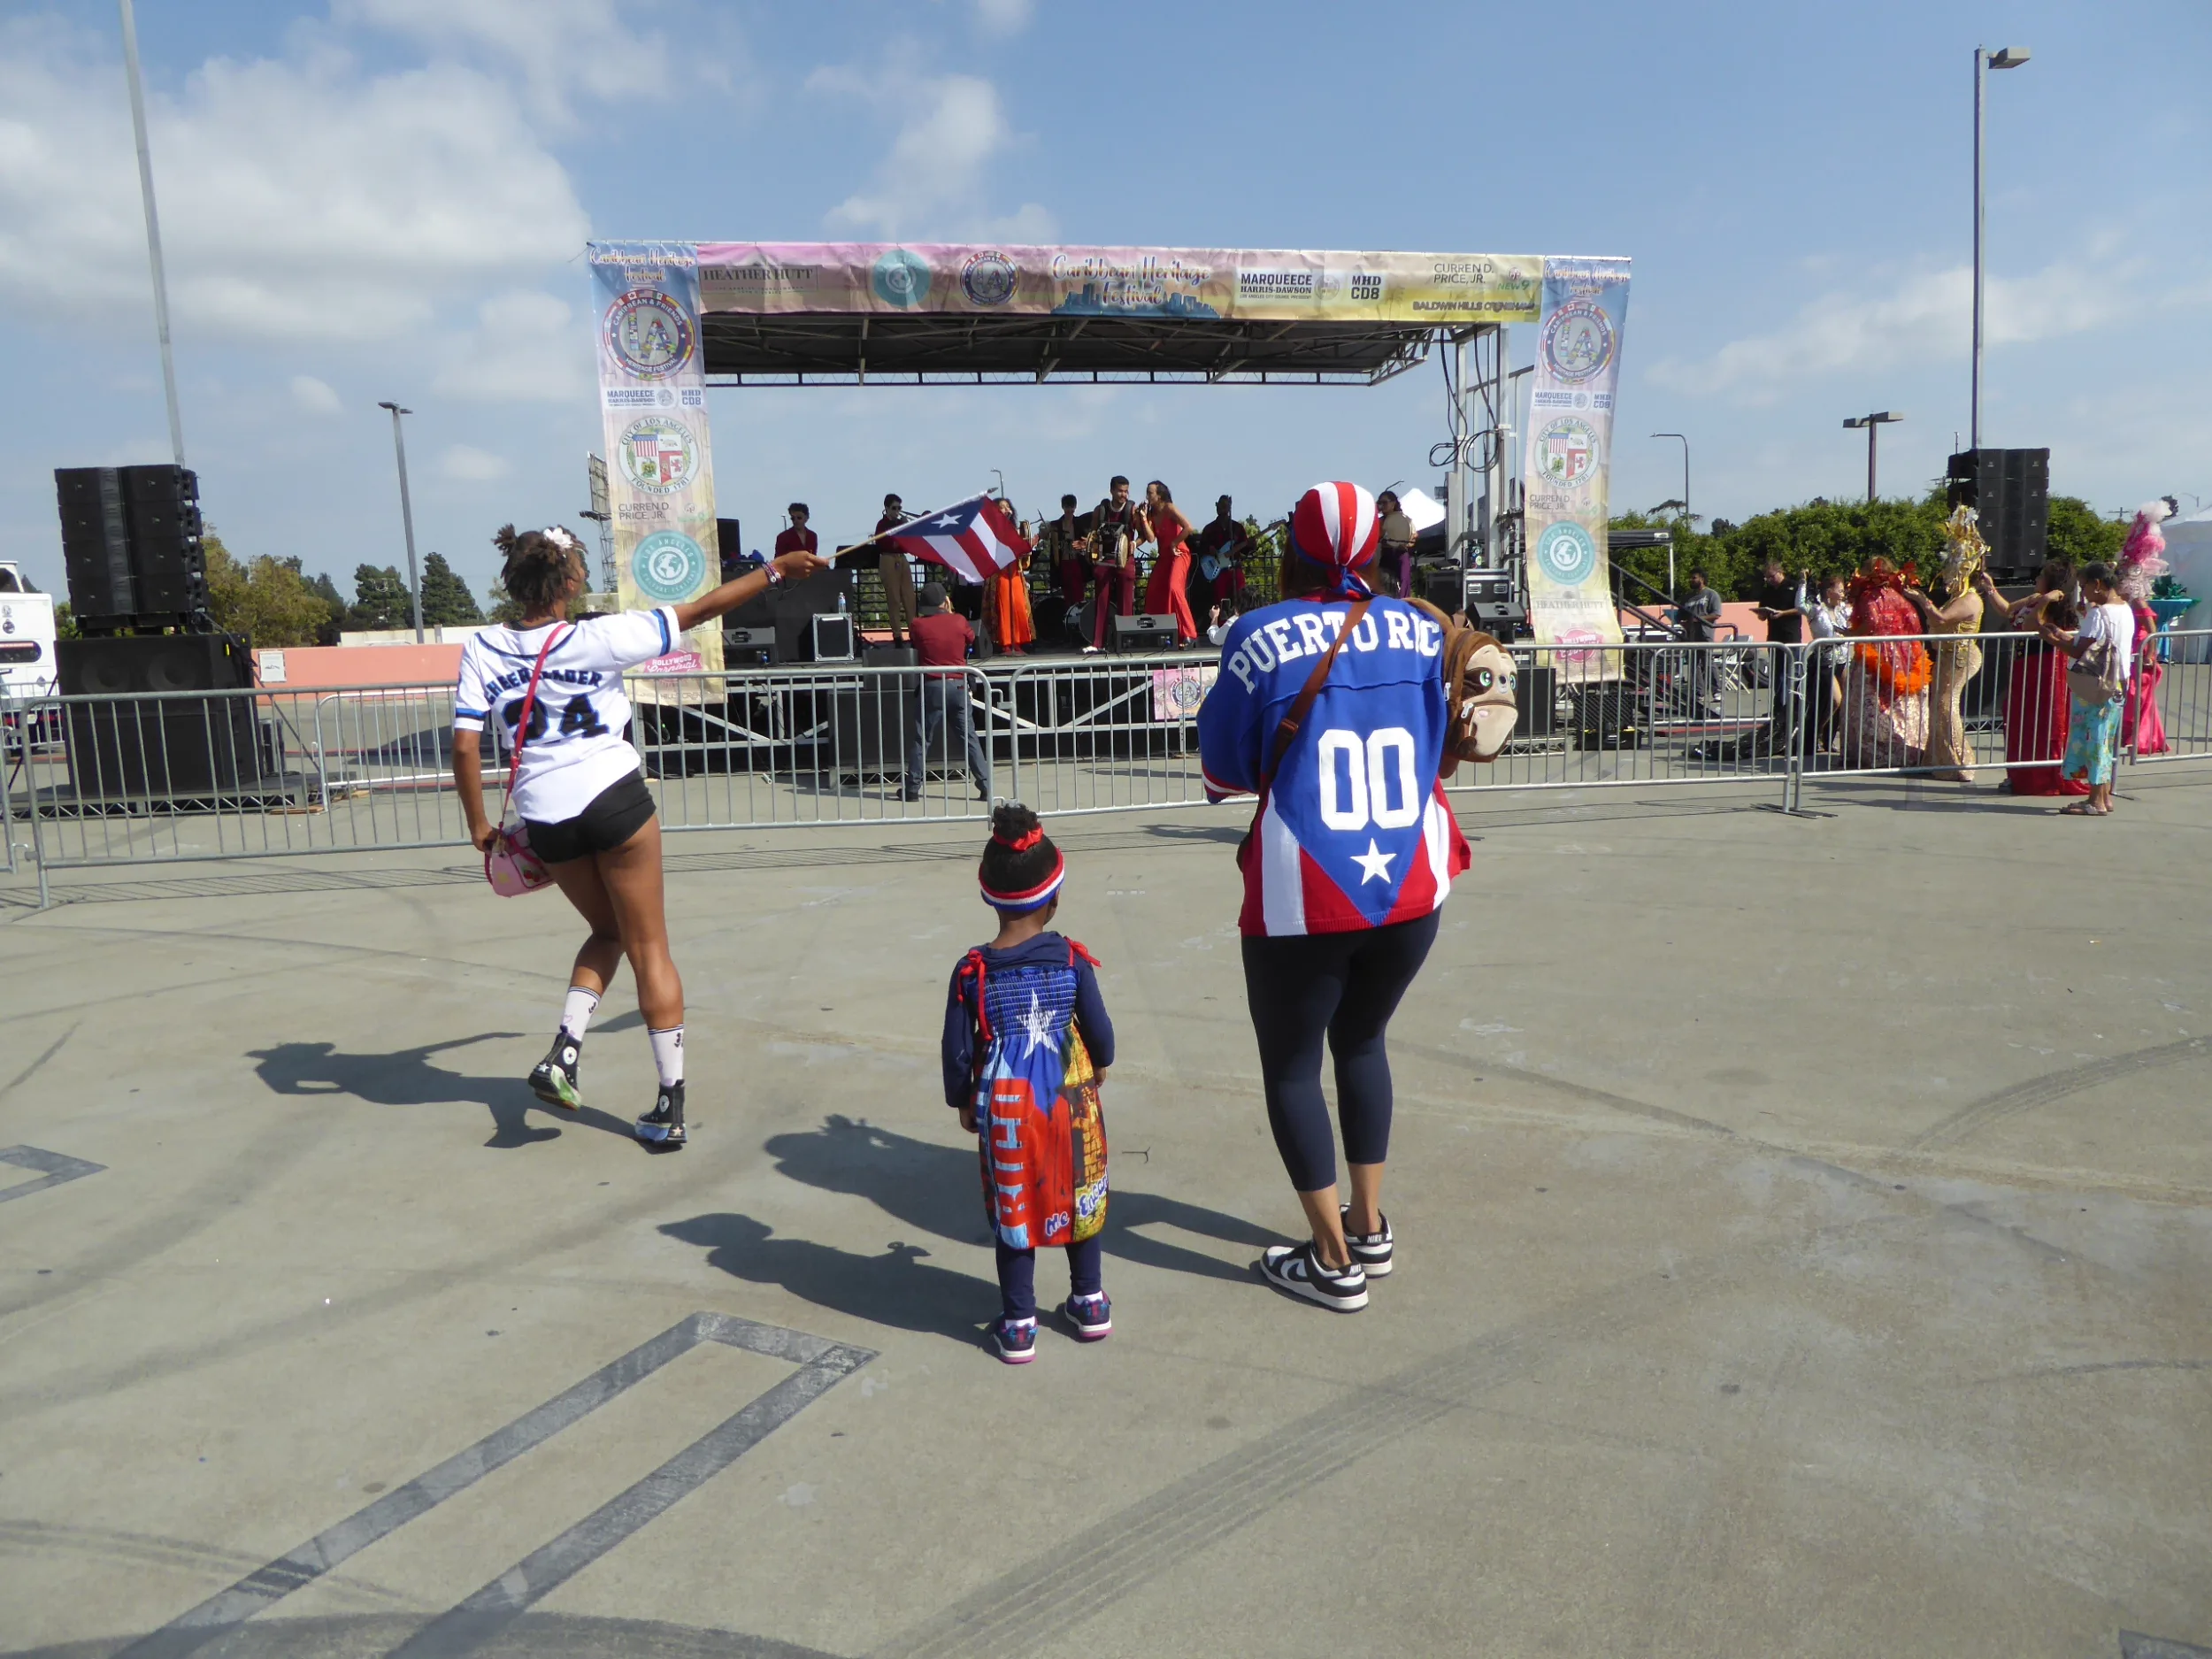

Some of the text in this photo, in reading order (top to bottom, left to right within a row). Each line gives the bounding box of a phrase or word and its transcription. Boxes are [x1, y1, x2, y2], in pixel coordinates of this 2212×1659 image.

[590, 248, 695, 270] Caribbean Heritage
[625, 265, 666, 282] Festival
[703, 268, 813, 280] HEATHER HUTT
[1053, 255, 1210, 285] Caribbean Heritage
[1433, 263, 1494, 273] CURREN D.
[1240, 273, 1312, 286] MARQUEECE
[1352, 275, 1381, 286] MHD
[1433, 273, 1486, 284] PRICE, JR.
[1102, 281, 1162, 306] Festival
[1351, 287, 1379, 300] CD8
[613, 298, 648, 326] CARIBBEAN
[657, 300, 683, 326] FRIENDS
[1413, 301, 1456, 311] BALDWIN
[1458, 301, 1483, 311] HILLS
[626, 357, 678, 372] HERITAGE FESTIVAL
[622, 430, 634, 446] CITY
[664, 419, 693, 444] ANGELES
[1575, 420, 1596, 443] ANGELES
[632, 477, 689, 494] FOUNDED 1781
[1542, 471, 1572, 487] FOUNDED
[1529, 494, 1562, 503] CURREN
[618, 502, 659, 511] CURREN
[652, 654, 692, 666] HOLLYWOOD
[1227, 611, 1379, 695] PUERTO
[484, 668, 603, 705] CHEEREADER
[1318, 727, 1420, 831] 00
[1367, 1234, 1382, 1243] NIKE
[1349, 1263, 1362, 1275] NIKE
